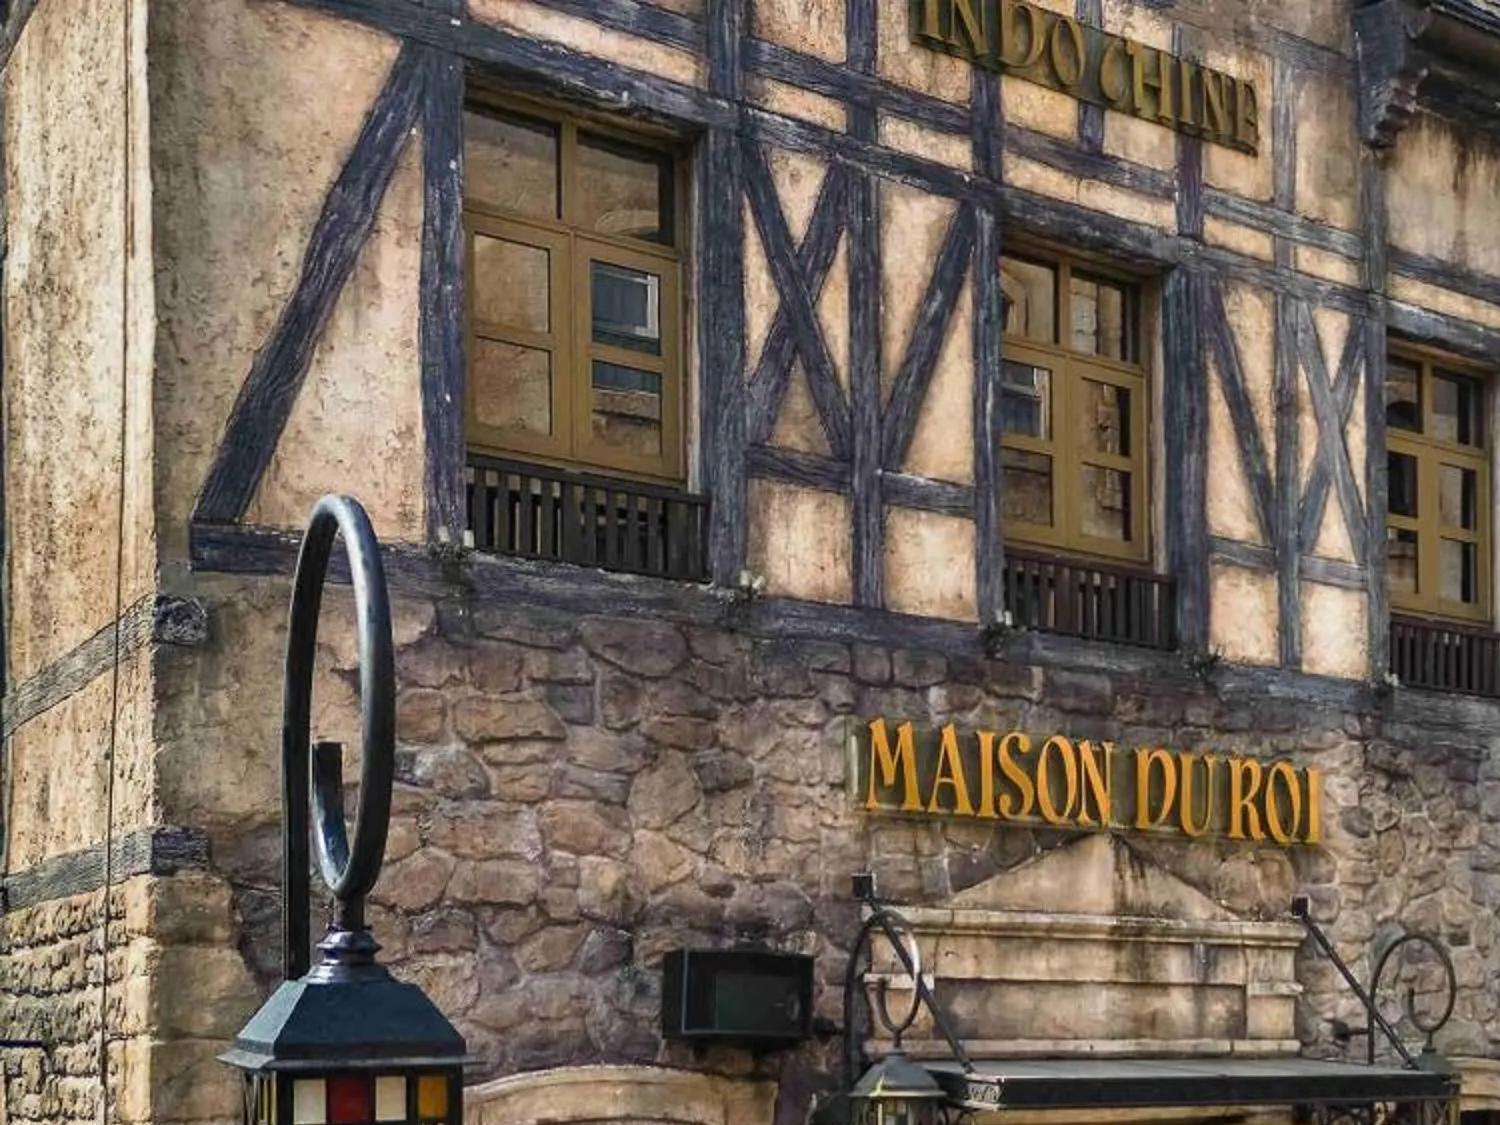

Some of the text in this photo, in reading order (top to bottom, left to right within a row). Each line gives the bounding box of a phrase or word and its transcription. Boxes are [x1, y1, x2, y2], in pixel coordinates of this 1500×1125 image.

[865, 718, 1322, 844] MAISON DU ROI
